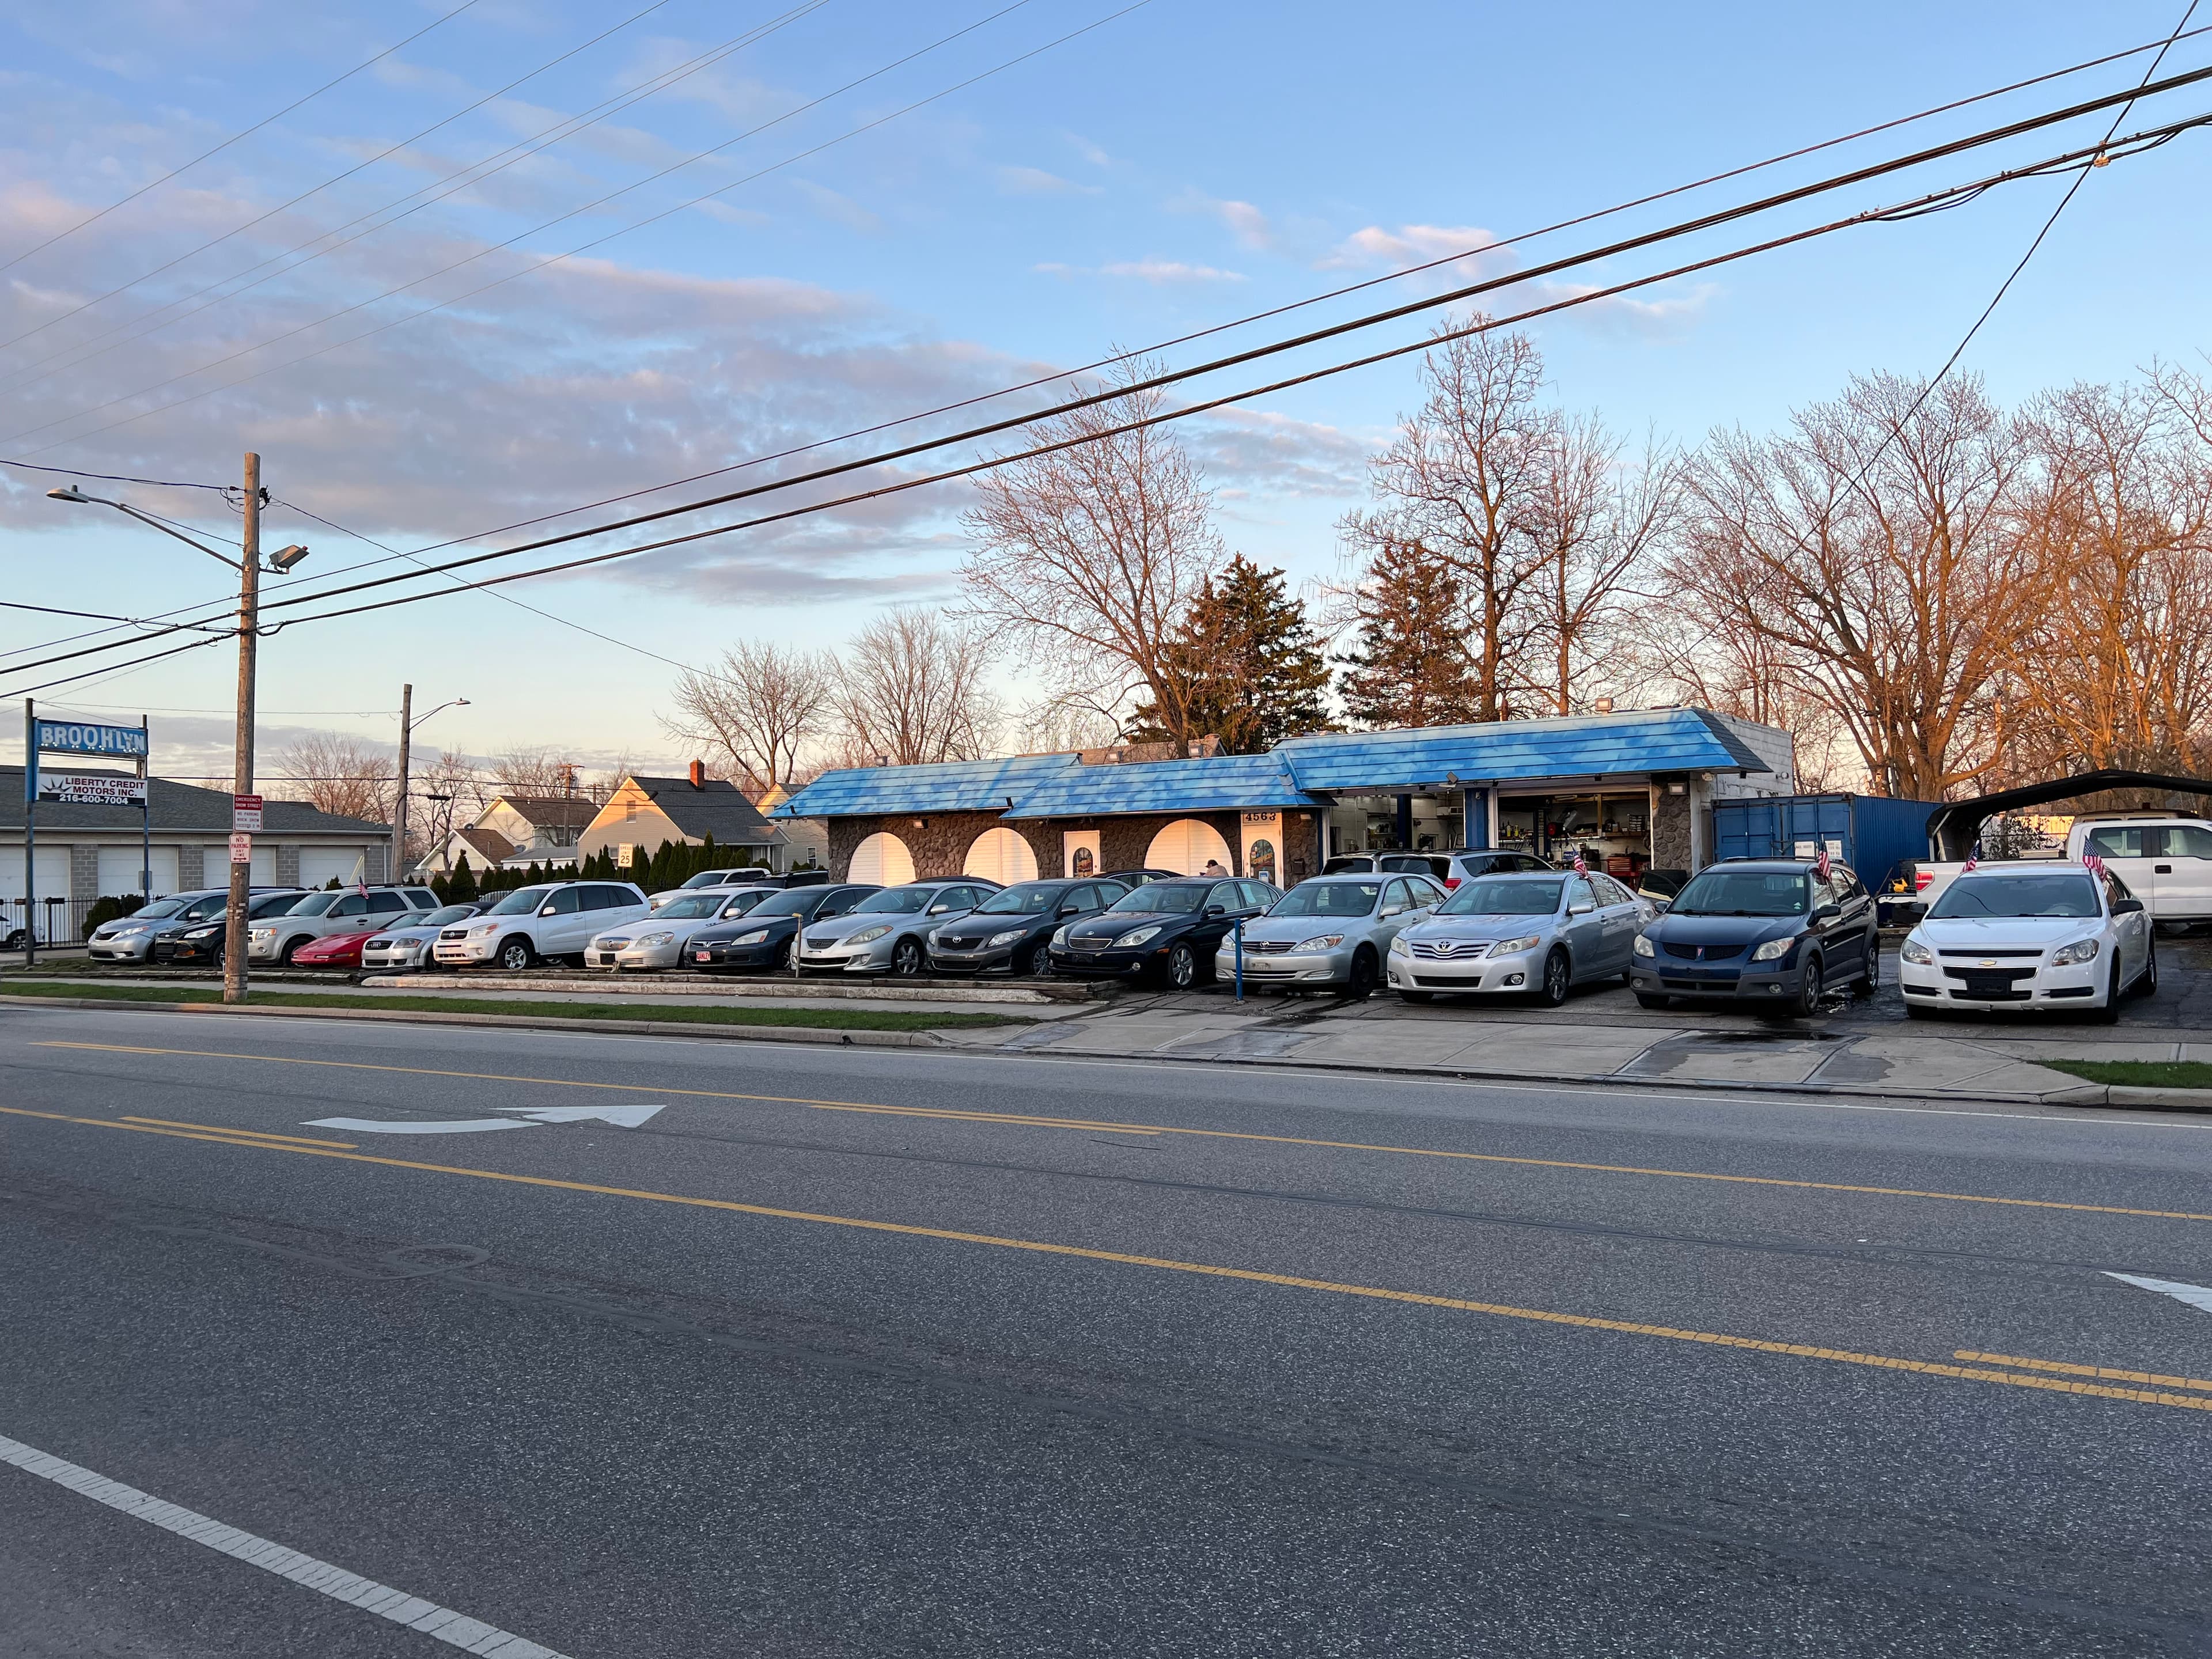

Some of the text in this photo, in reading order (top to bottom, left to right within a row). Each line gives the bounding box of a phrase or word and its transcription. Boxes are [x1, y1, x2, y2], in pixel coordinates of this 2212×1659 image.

[65, 778, 145, 789] LIBERTY CREDIT
[73, 786, 115, 796] MOTORS
[59, 794, 128, 804] 216-600-7004
[1245, 812, 1276, 821] 4563
[620, 855, 630, 863] 25
